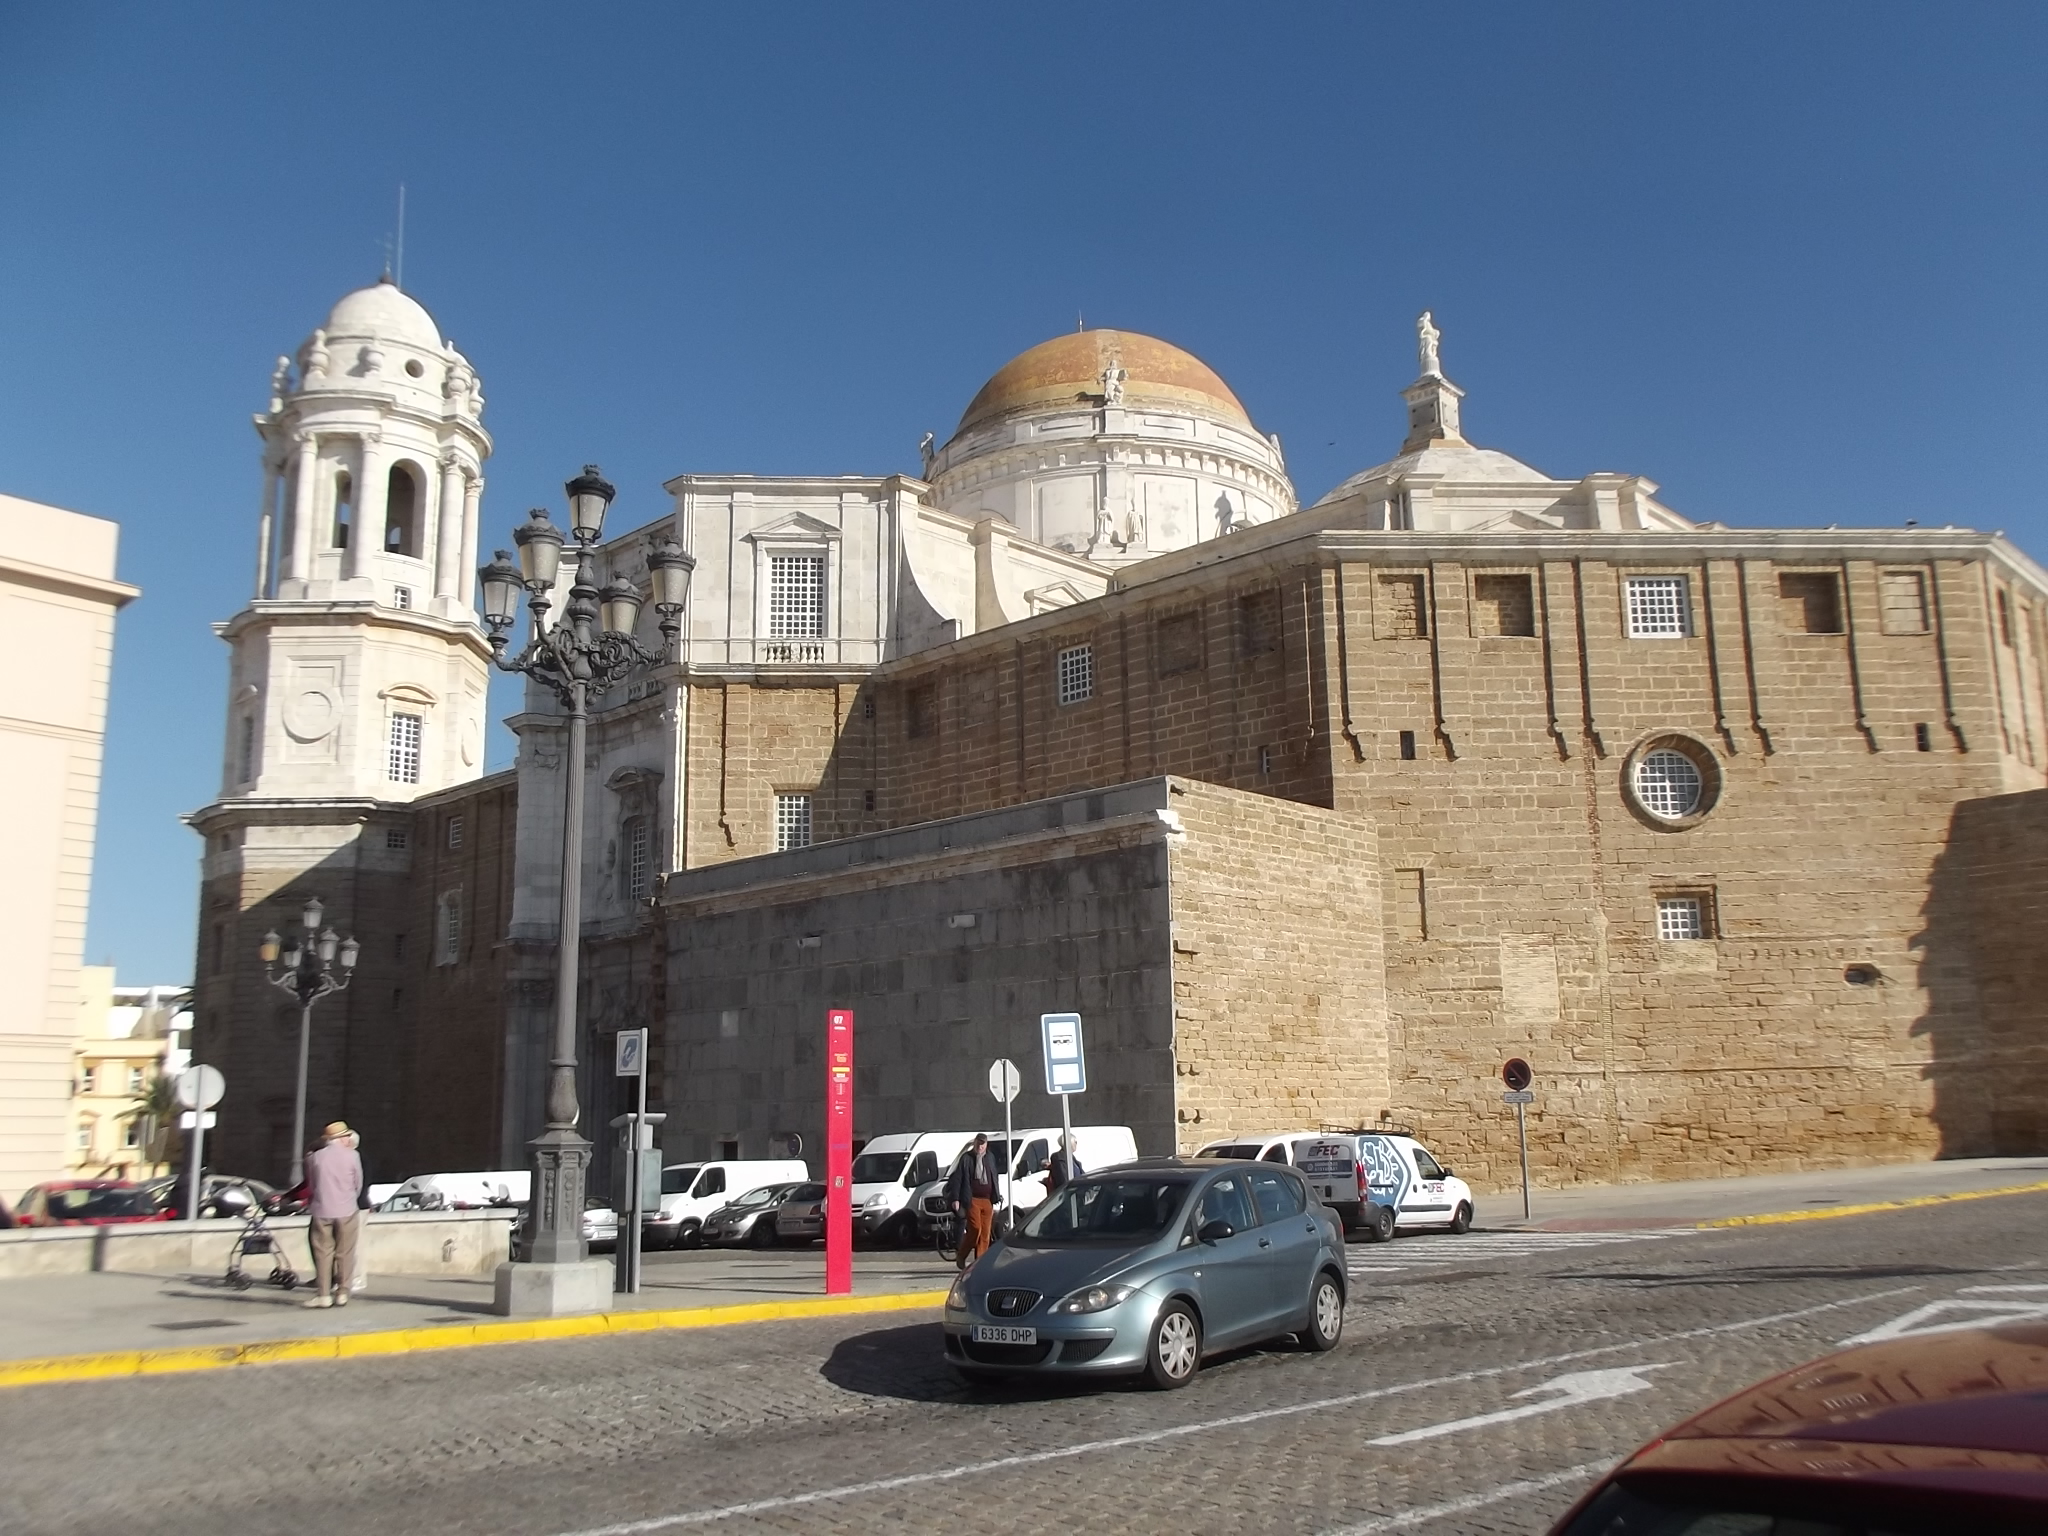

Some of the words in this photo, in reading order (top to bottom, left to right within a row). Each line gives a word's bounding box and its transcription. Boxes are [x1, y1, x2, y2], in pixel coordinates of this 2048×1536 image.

[833, 1015, 844, 1025] 07
[981, 1327, 1007, 1341] 6336
[1011, 1328, 1032, 1342] DHP
